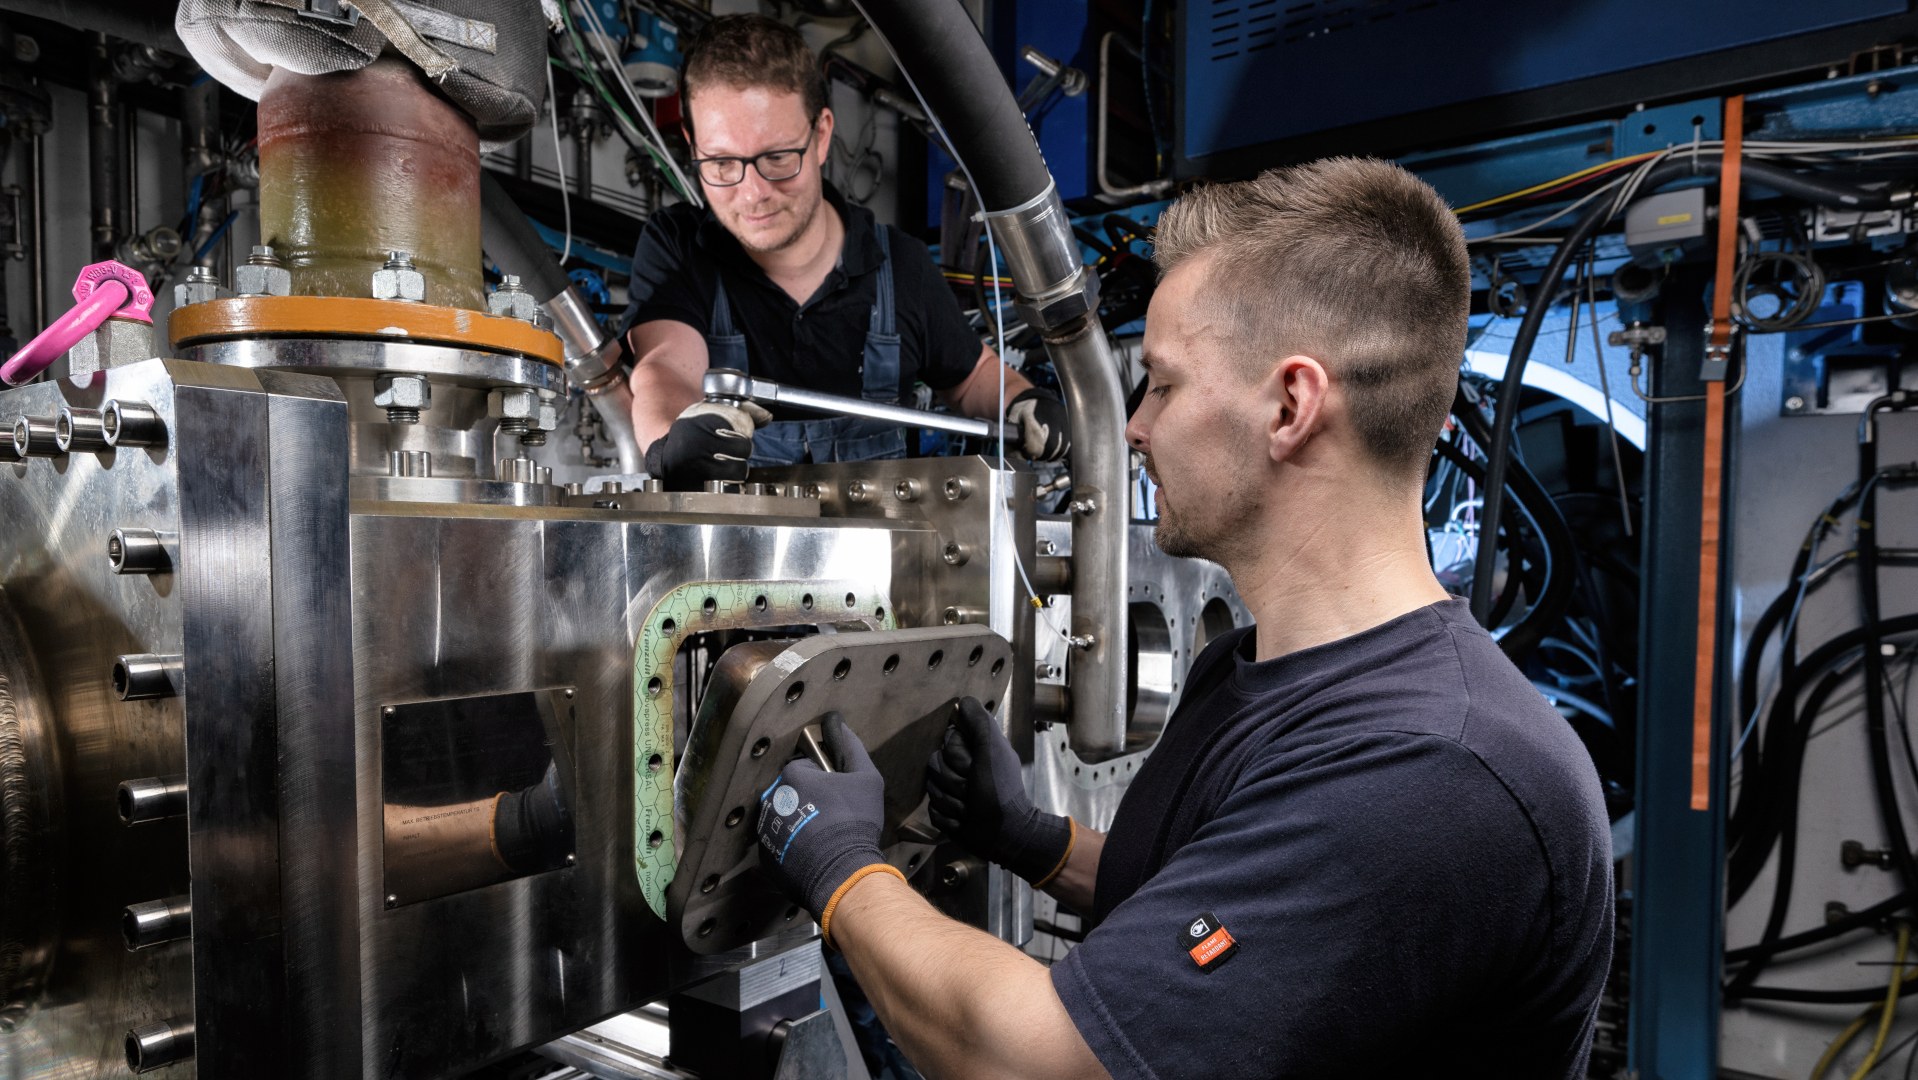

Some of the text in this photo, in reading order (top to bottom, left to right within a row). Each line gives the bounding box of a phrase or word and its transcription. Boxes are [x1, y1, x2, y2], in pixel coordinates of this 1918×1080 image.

[1200, 939, 1228, 960] RETARDANT
[1201, 937, 1217, 950] FLAME
[779, 957, 788, 977] 2
